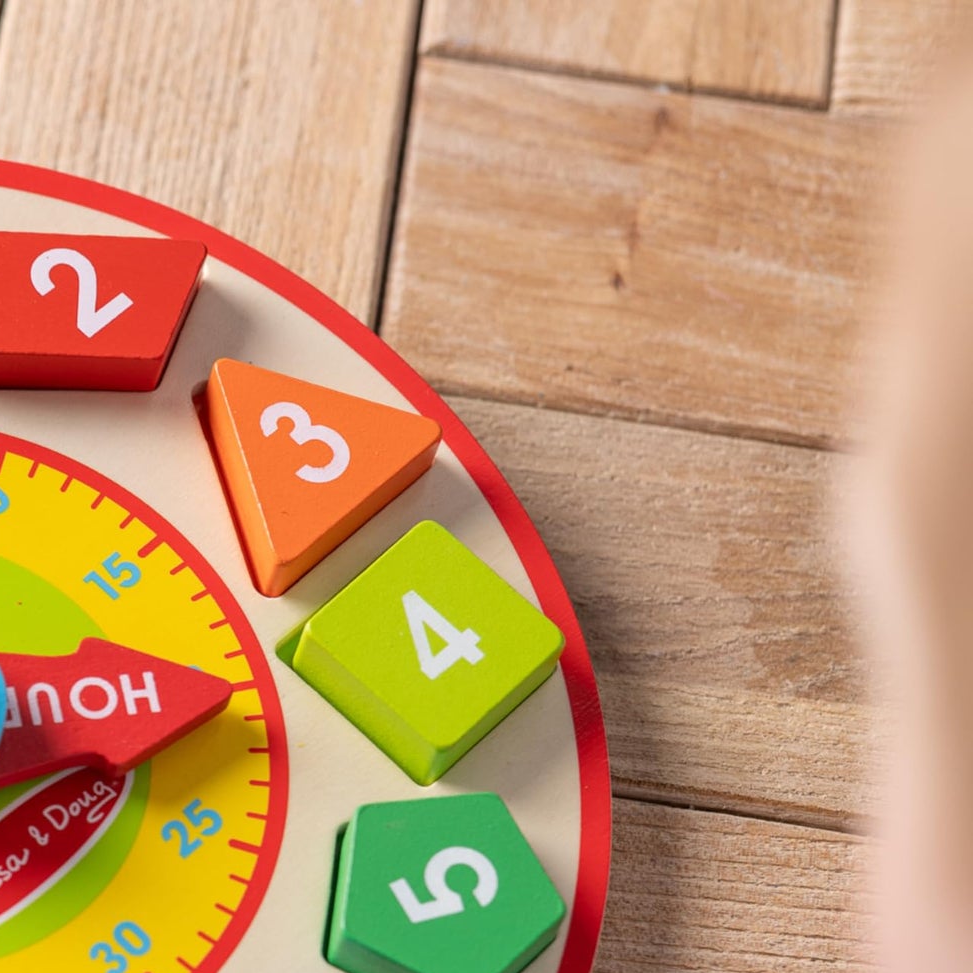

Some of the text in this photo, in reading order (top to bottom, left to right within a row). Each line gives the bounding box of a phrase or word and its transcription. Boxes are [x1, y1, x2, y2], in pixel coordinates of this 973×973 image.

[30, 248, 134, 338] 2
[259, 401, 350, 483] 3
[84, 552, 141, 599] 15
[402, 590, 485, 680] 4
[27, 825, 49, 846] &
[42, 780, 118, 831] Doug
[161, 799, 223, 858] 25
[389, 846, 499, 924] 5
